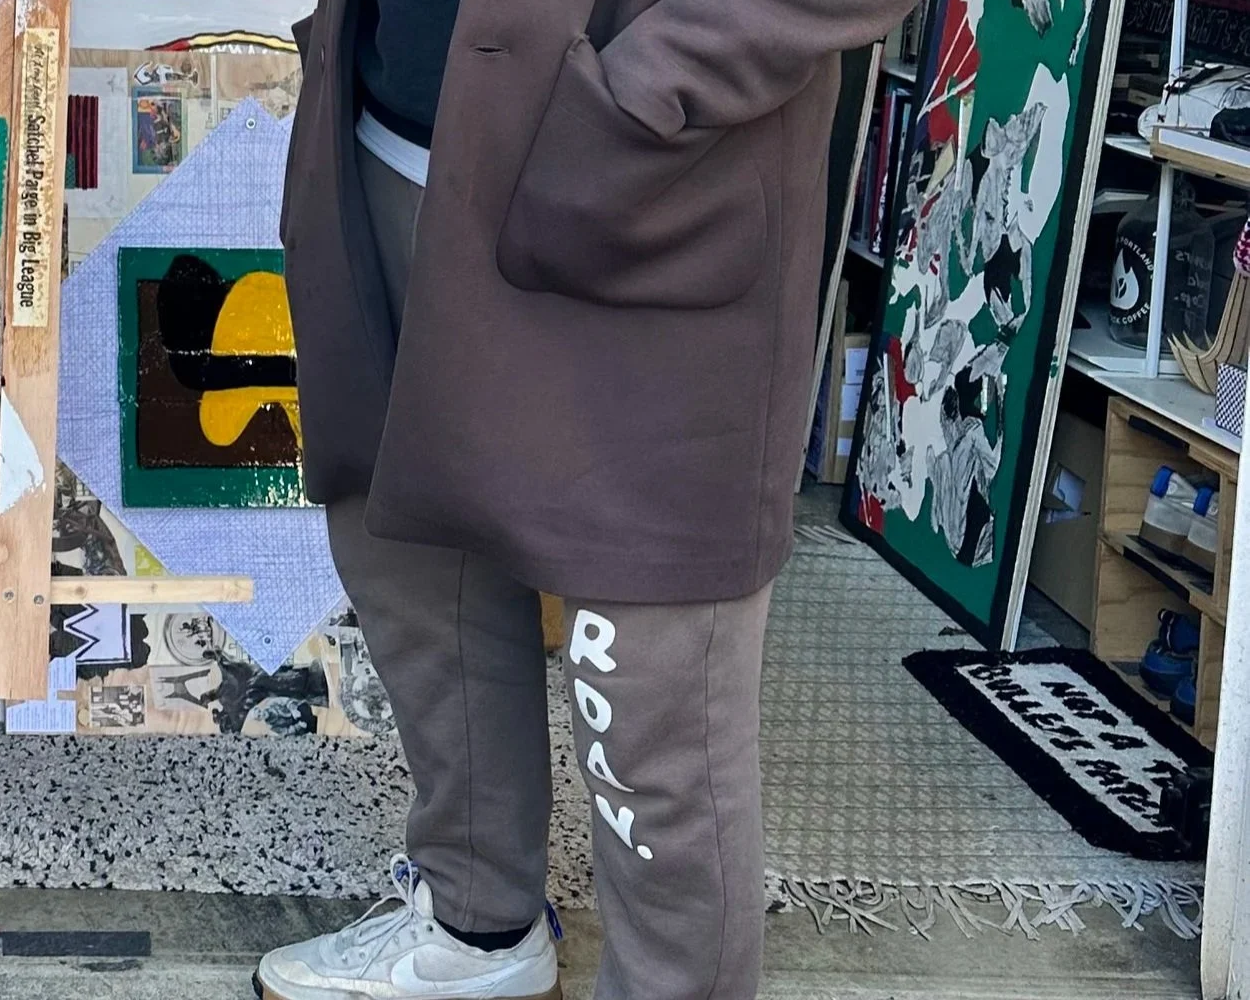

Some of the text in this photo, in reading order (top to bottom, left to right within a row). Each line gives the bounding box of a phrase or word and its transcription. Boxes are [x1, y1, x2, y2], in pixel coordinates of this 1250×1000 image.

[17, 114, 46, 308] Satchel Paige in Big League
[1122, 302, 1151, 325] COFFEE
